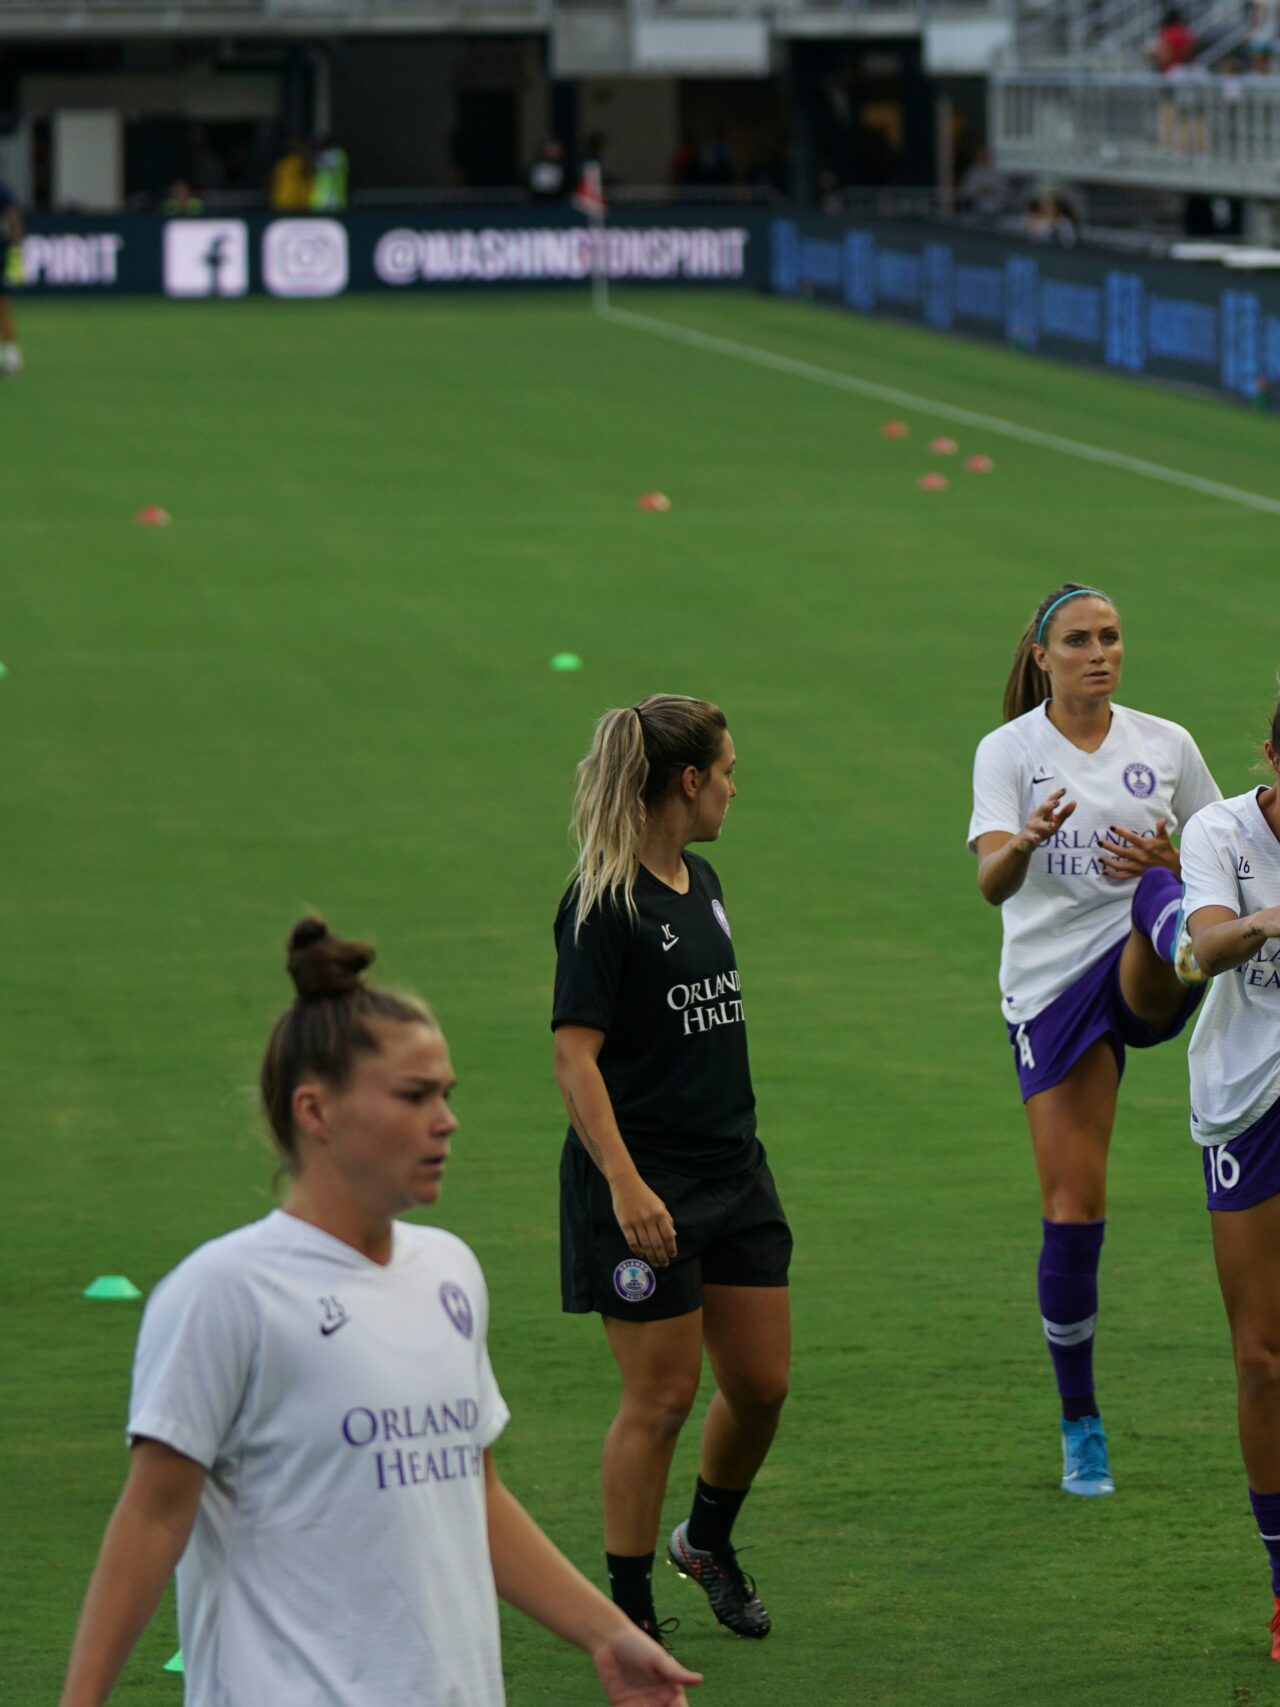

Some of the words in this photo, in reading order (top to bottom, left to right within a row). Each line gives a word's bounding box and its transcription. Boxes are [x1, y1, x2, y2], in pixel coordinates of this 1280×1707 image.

[22, 232, 123, 285] PIRIT
[1238, 856, 1251, 873] 16
[666, 969, 741, 1011] ORLAND
[1208, 1142, 1241, 1194] 16
[342, 1398, 479, 1448] ORLAND
